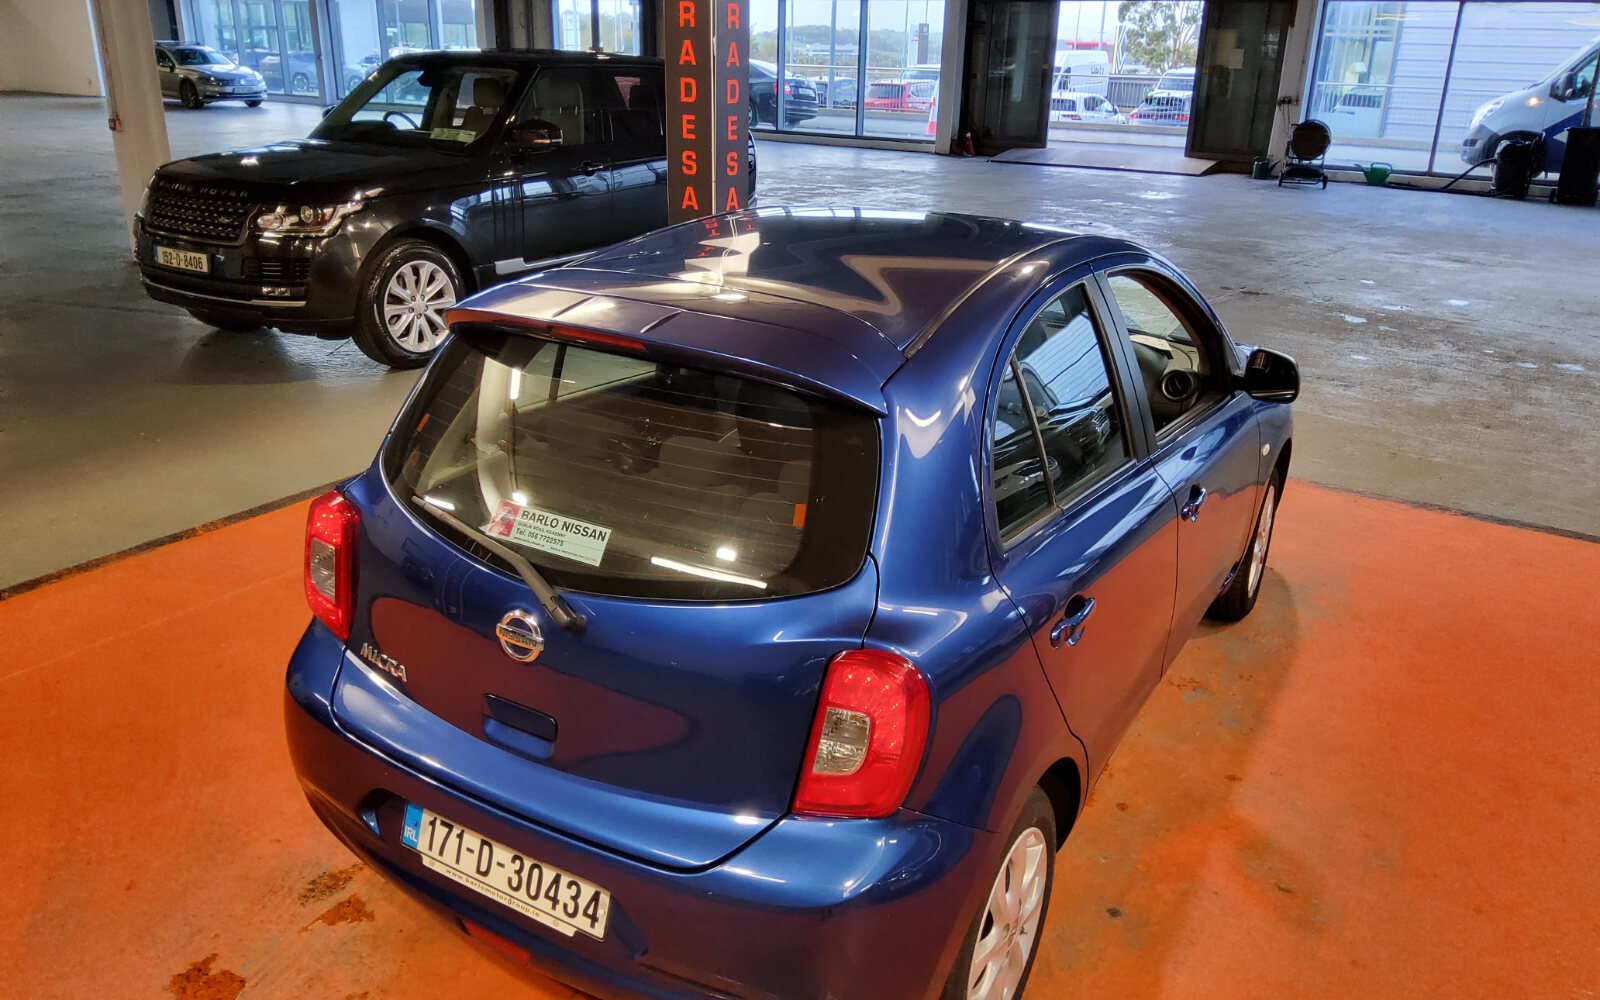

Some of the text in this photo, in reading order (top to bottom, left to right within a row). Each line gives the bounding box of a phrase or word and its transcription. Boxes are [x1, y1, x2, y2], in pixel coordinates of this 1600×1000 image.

[516, 527, 527, 536] Tel:
[539, 533, 565, 547] 7722575
[521, 510, 559, 528] BARLO
[562, 521, 607, 542] NISSAN
[499, 628, 537, 648] NISSAN
[360, 642, 407, 683] MICRA
[404, 825, 418, 842] IRL
[428, 816, 602, 929] 171-D-30434
